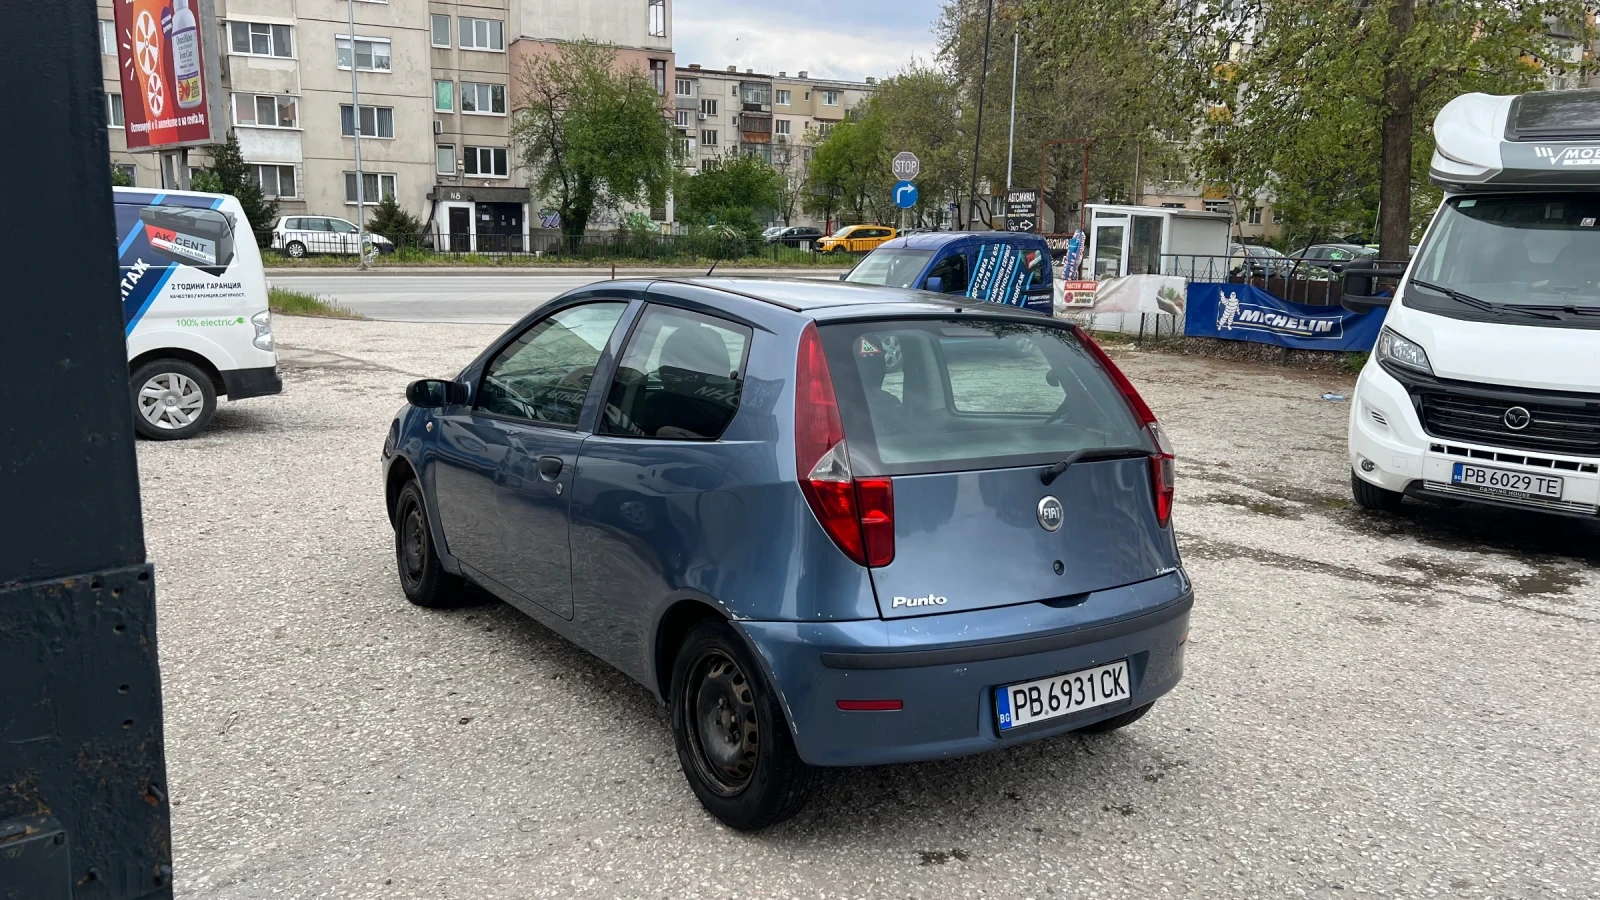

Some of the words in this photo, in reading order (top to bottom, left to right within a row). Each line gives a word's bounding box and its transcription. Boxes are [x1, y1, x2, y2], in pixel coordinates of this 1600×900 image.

[895, 160, 917, 173] STOP
[177, 283, 206, 291] ГОДИНИ
[207, 282, 242, 291] ГАРАНЦИЯ
[972, 258, 989, 299] ДОСТАВКА
[1011, 272, 1026, 305] МОНТАЖ
[176, 318, 199, 327] 100%
[200, 317, 233, 327] electric
[1239, 309, 1334, 333] MICHELIN
[1464, 467, 1486, 484] PB
[1489, 471, 1531, 490] 6029
[1536, 477, 1558, 495] TE
[1479, 486, 1507, 495] CAMPING
[1043, 507, 1060, 520] FIAT
[892, 593, 948, 609] Punto
[1000, 712, 1010, 724] BG
[1013, 686, 1044, 720] PB
[1048, 673, 1096, 712] 6931
[1100, 666, 1126, 699] CK
